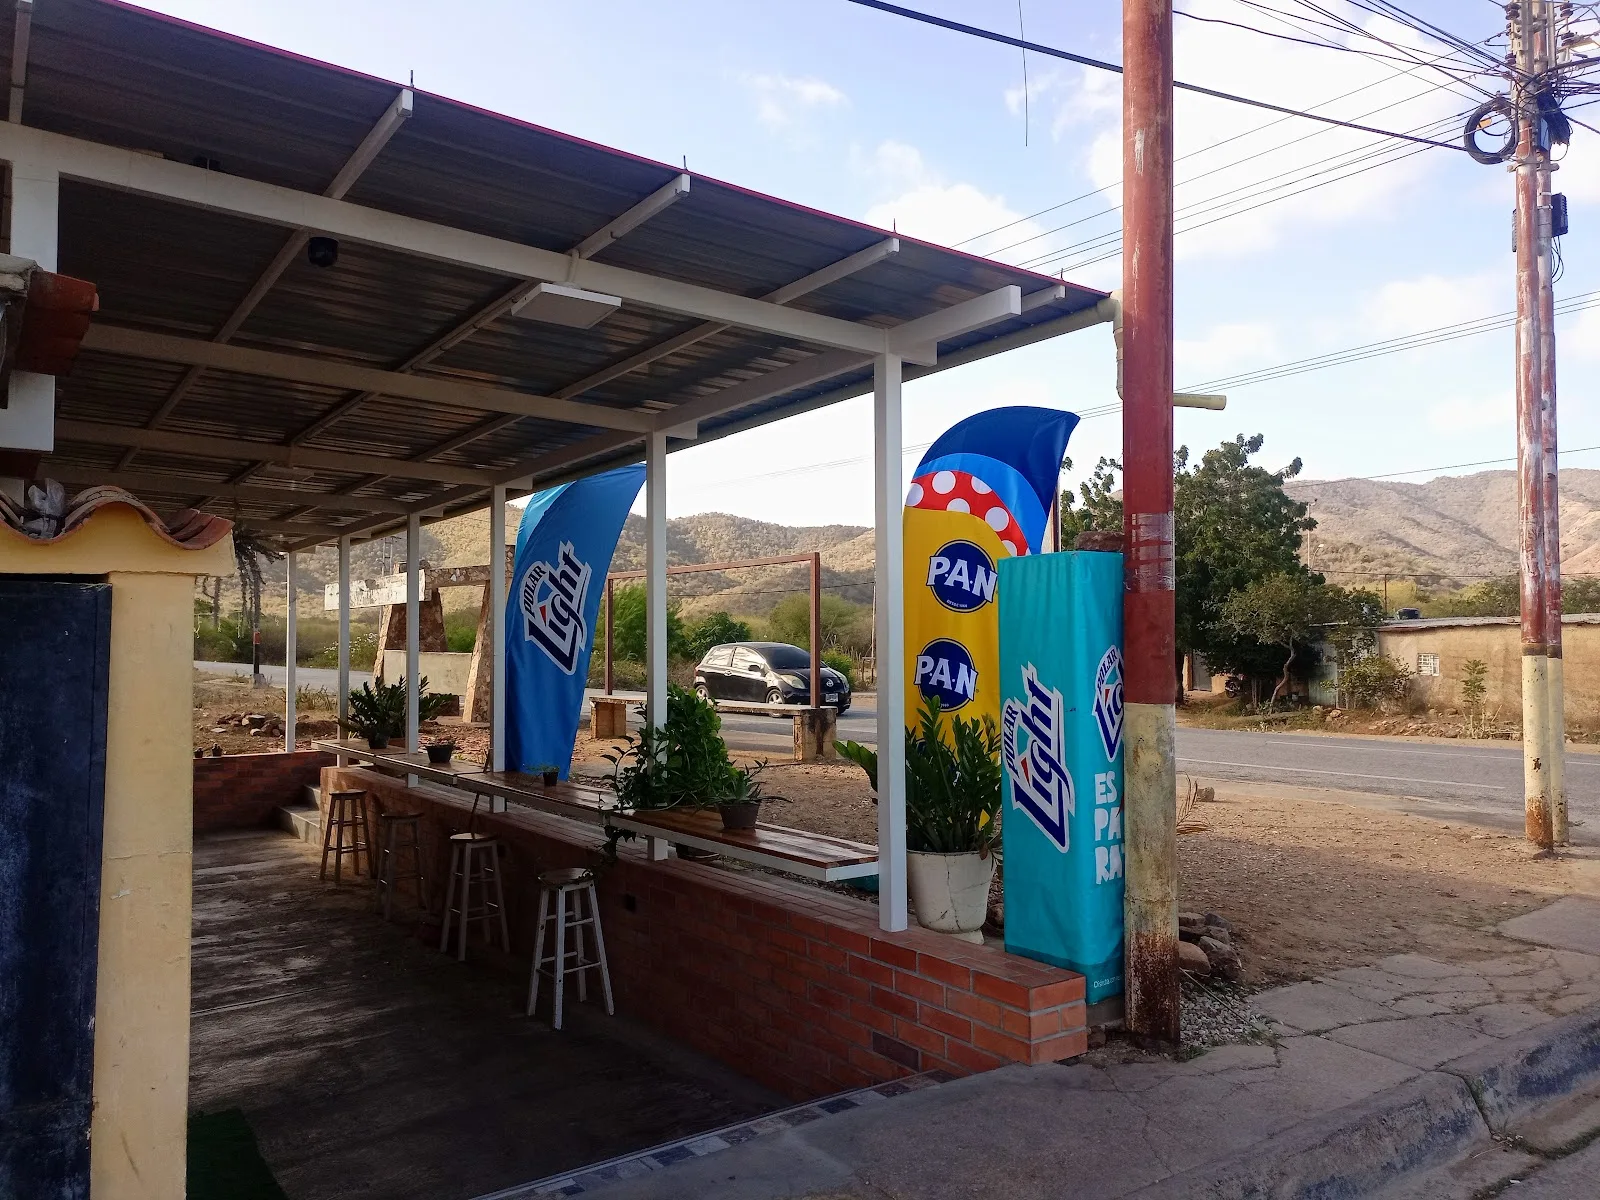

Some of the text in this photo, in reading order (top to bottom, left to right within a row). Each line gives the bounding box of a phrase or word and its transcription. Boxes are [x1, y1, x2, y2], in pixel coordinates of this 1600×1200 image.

[523, 564, 547, 619] POLAR
[526, 546, 590, 672] Light
[1097, 647, 1118, 696] POLAR
[1005, 703, 1020, 779] POLAR
[1013, 670, 1073, 849] Light
[1095, 770, 1118, 805] ES
